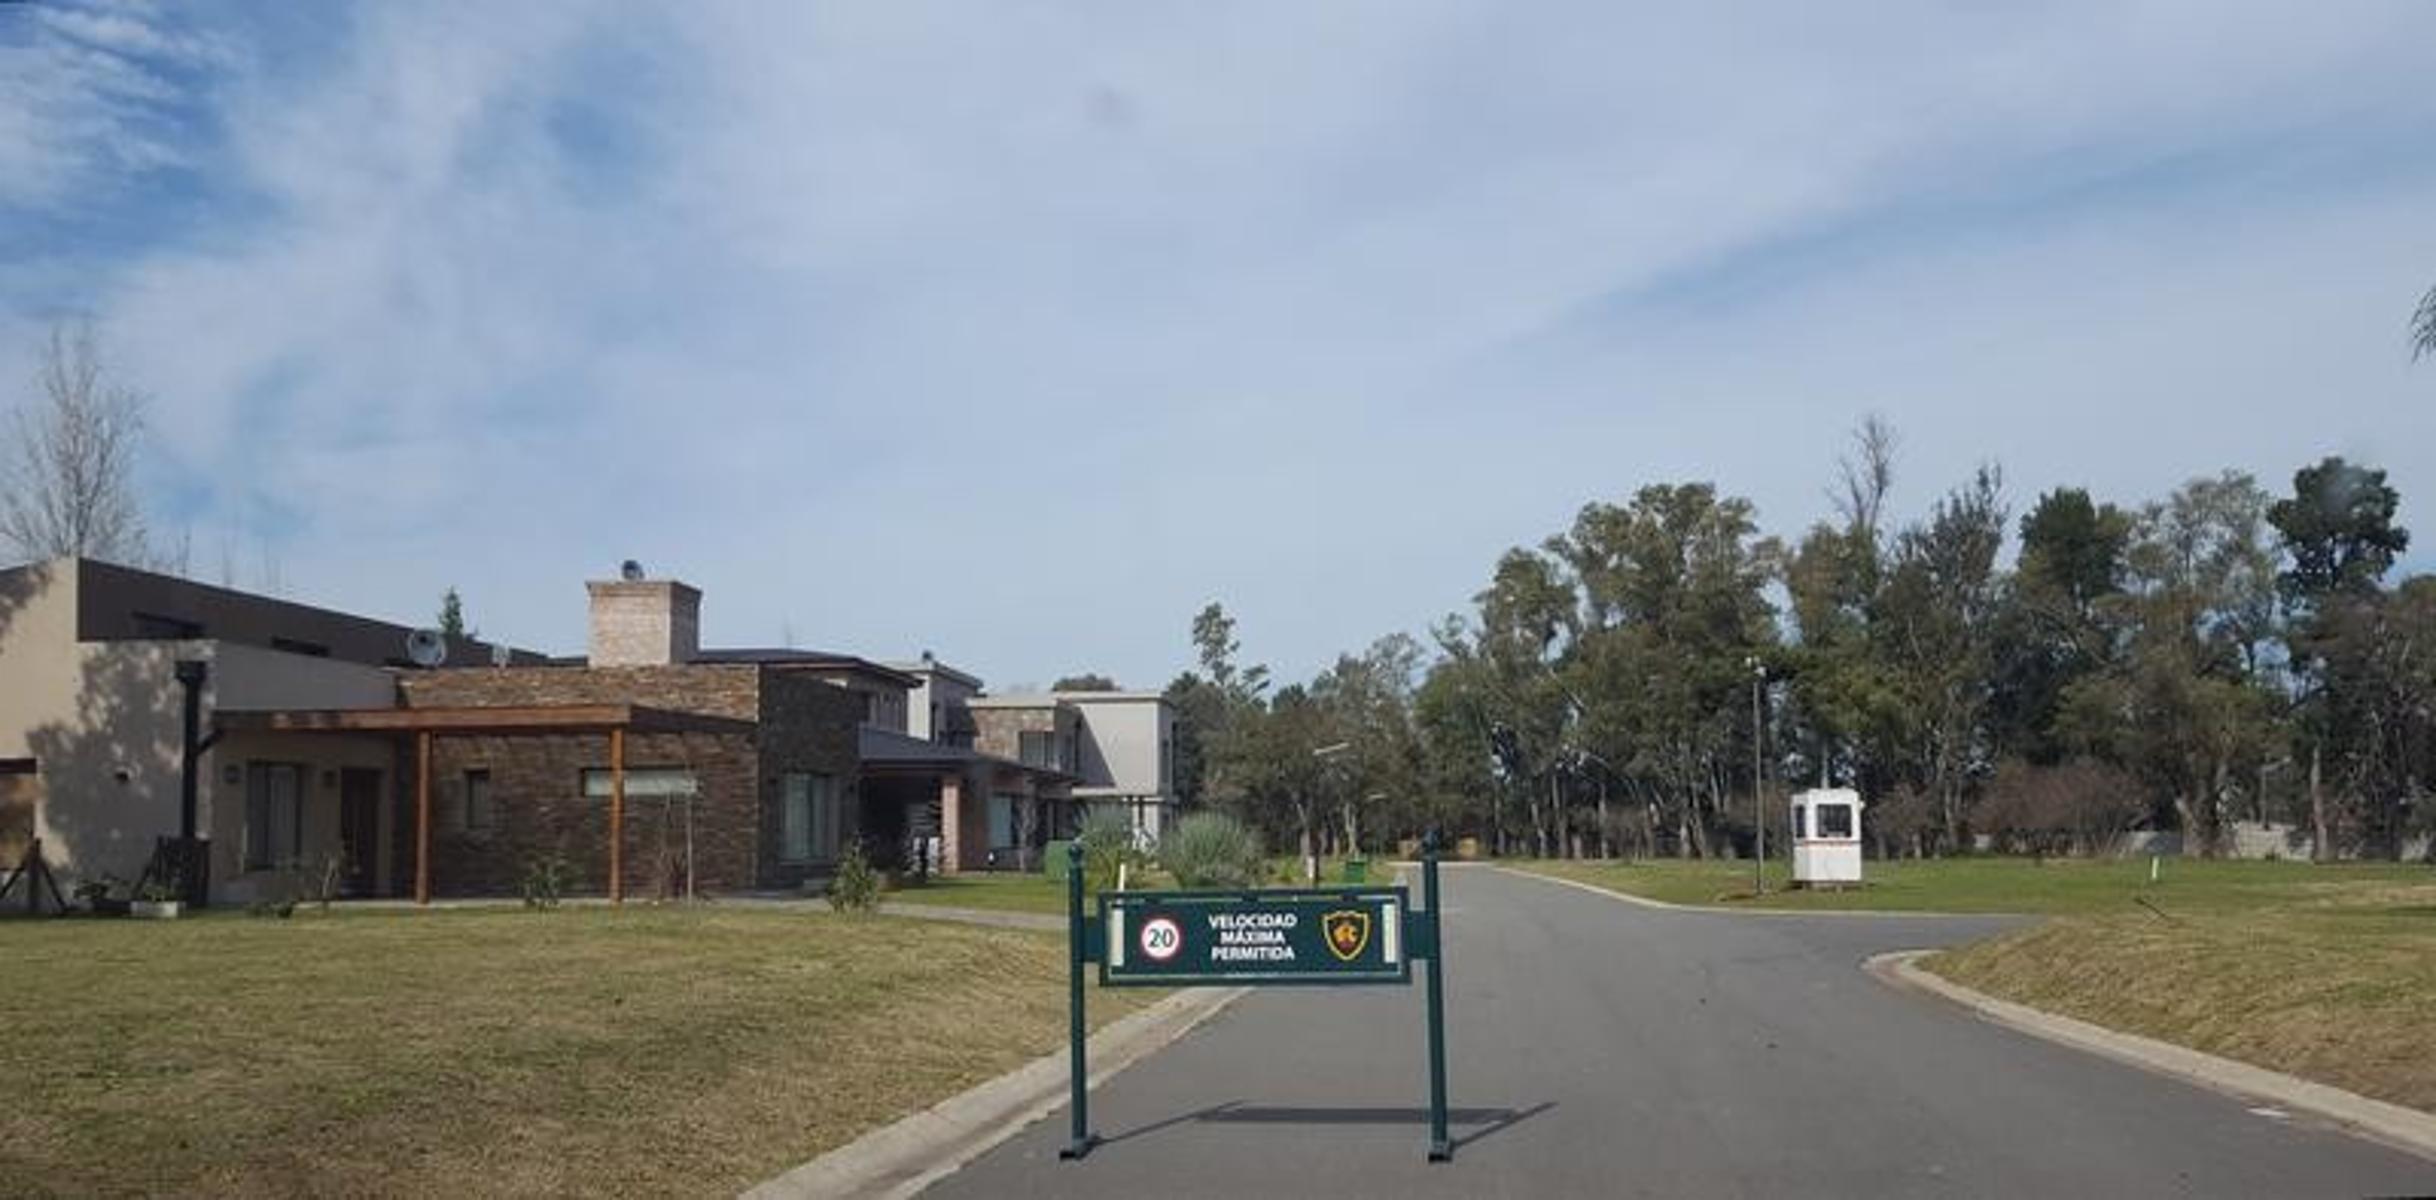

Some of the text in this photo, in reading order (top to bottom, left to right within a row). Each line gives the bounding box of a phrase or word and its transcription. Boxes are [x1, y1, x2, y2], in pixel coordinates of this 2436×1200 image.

[1208, 914, 1298, 928] VELOCIDAD
[1148, 928, 1175, 947] 20
[1220, 928, 1286, 944] MÁXIMA
[1211, 946, 1295, 961] PERMITIDA
